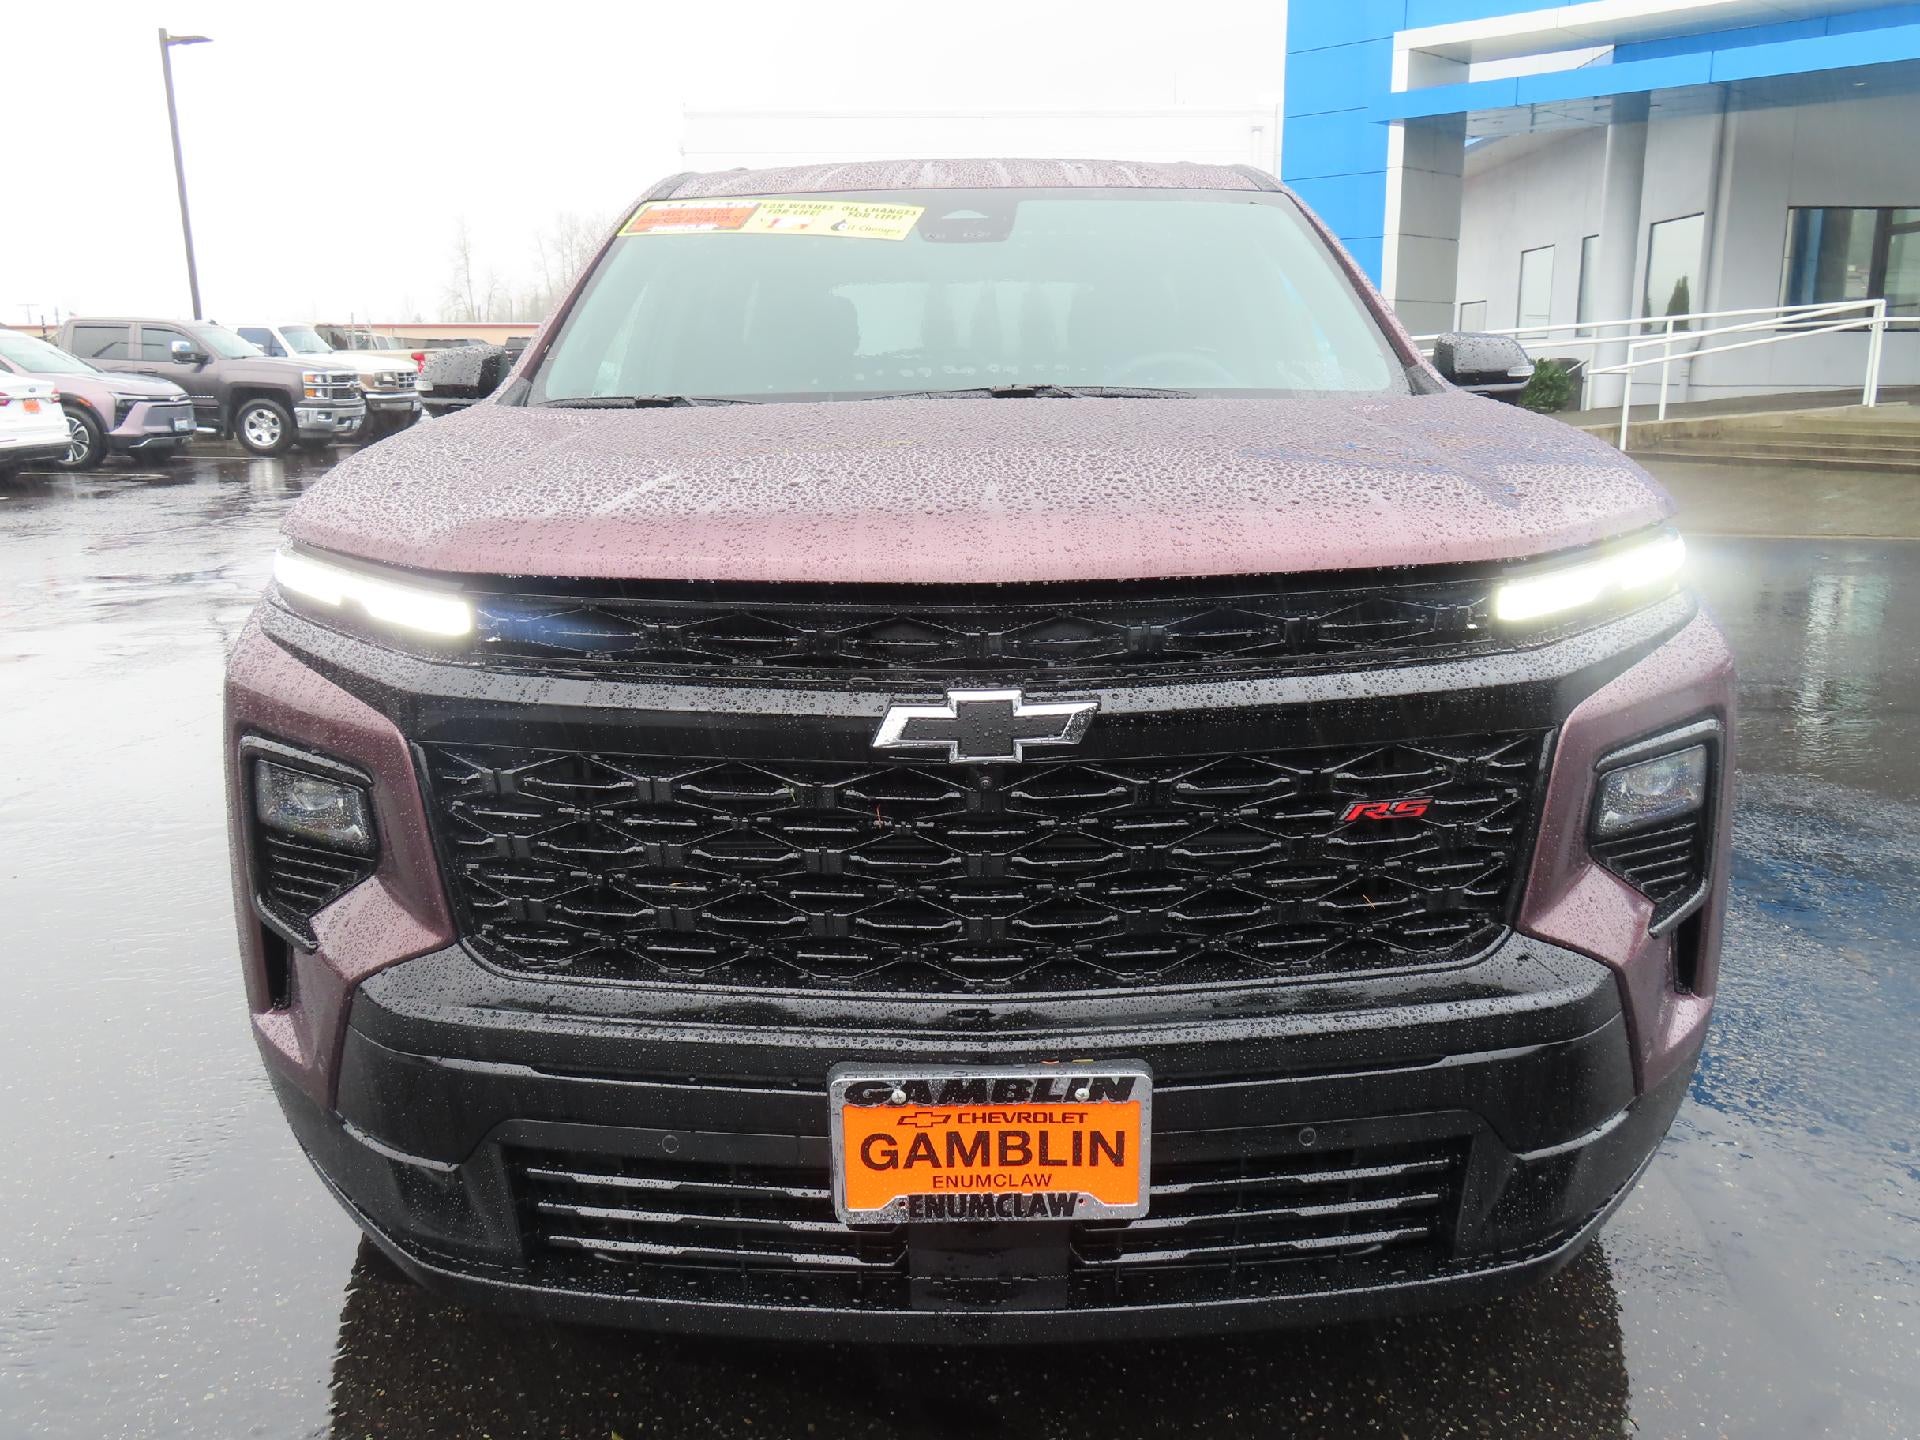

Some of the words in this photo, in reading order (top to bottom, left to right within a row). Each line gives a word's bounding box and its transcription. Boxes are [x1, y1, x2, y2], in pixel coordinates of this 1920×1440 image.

[1340, 798, 1433, 822] RS
[844, 1076, 1137, 1105] GAMBLIN
[957, 1111, 1088, 1124] CHEVROLET
[860, 1130, 1124, 1171] GAMBLIN
[932, 1174, 1052, 1188] ENUMCLAW
[907, 1192, 1079, 1218] ENUMCLAW
